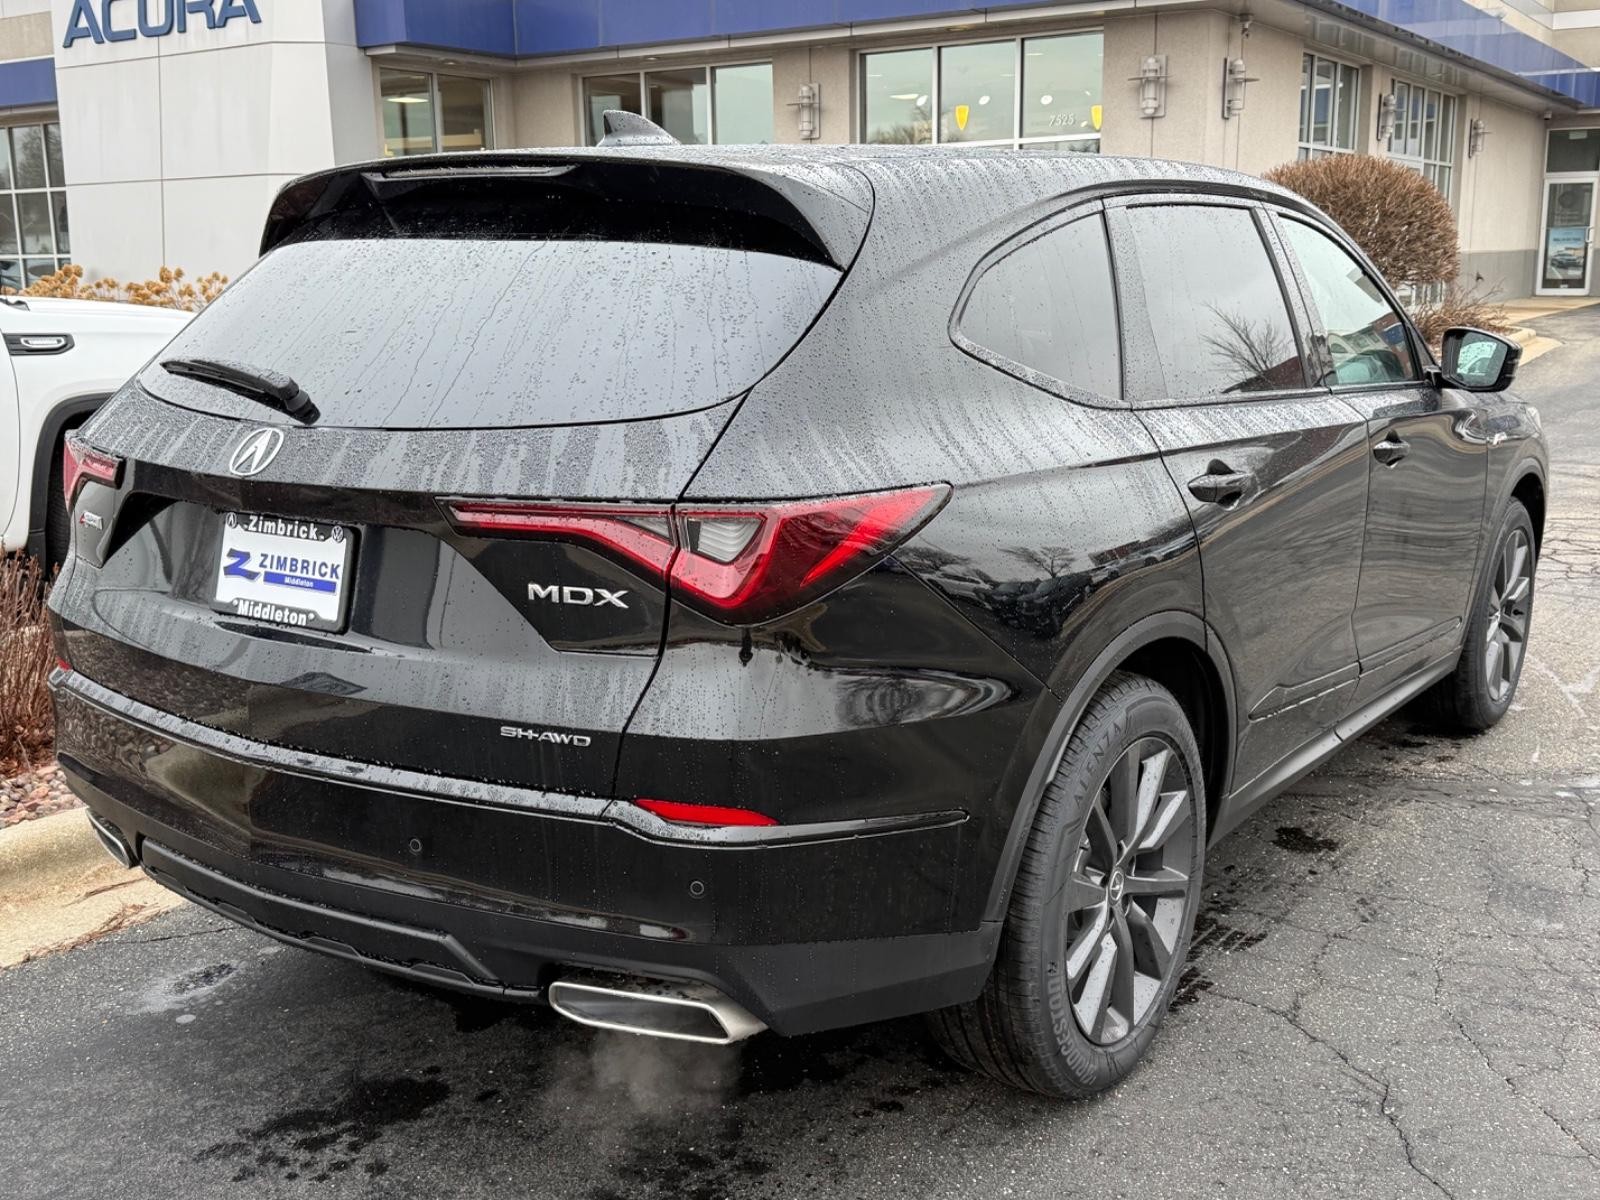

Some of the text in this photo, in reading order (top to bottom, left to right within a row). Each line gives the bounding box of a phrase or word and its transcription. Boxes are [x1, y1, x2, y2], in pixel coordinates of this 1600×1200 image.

[62, 0, 262, 48] ACURA
[1049, 112, 1075, 128] 7525
[248, 515, 318, 540] Zimbrick
[259, 553, 341, 580] ZIMBRICK
[284, 576, 314, 588] Middleton
[527, 583, 630, 609] MDX
[237, 599, 307, 626] Middleton
[500, 726, 592, 747] SH-AWD
[1073, 722, 1122, 807] ALENZA
